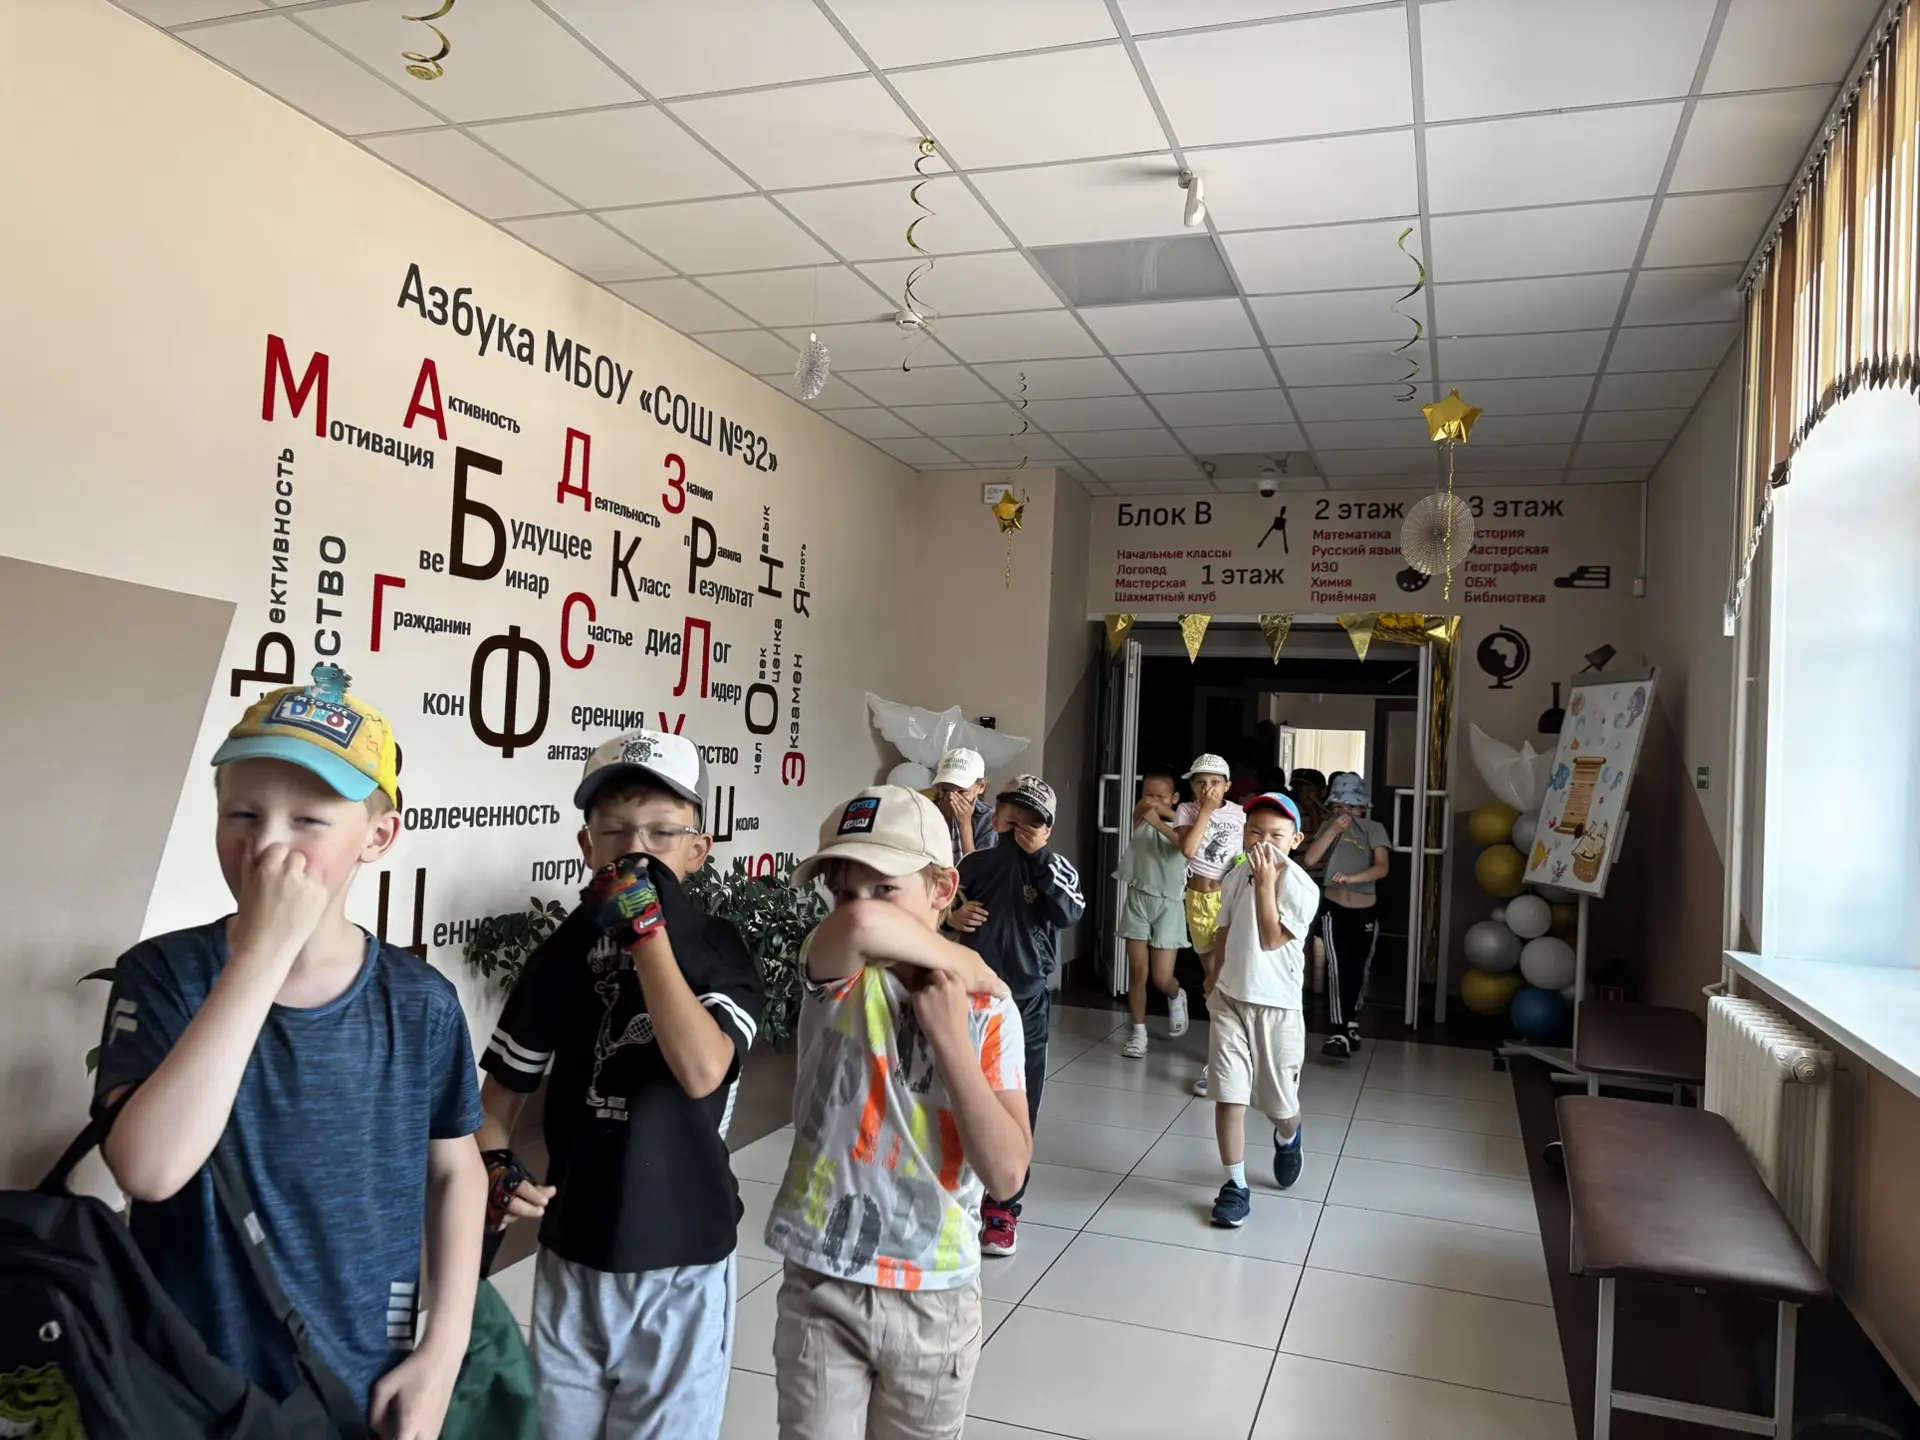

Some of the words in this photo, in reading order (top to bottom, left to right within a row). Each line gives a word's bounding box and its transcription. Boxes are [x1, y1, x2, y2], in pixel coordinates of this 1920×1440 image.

[397, 262, 535, 365] Азбука
[544, 329, 633, 405] МБОУ
[639, 385, 713, 446] «СОШ
[719, 416, 778, 472] №32»
[262, 333, 435, 469] Мотивация
[403, 357, 521, 441] Активность
[557, 427, 661, 528] Деятельность
[662, 453, 713, 514] Знания
[1117, 503, 1186, 527] Блок
[1314, 499, 1330, 520] 2
[1338, 501, 1404, 520] этаж
[1469, 495, 1484, 516] 3
[1492, 498, 1564, 517] этаж
[1312, 529, 1391, 541] Математика
[1472, 528, 1525, 540] стория
[1117, 549, 1184, 560] Начальные
[1186, 548, 1232, 559] классы
[1312, 545, 1366, 557] Русский
[610, 530, 671, 603] Класс
[1116, 564, 1167, 576] Логопед
[1201, 564, 1214, 585] 1
[1221, 566, 1285, 585] этаж
[1311, 561, 1339, 573] ИЗО
[1464, 560, 1537, 573] География
[1115, 578, 1187, 590] Мастерская
[1311, 576, 1352, 588] Химия
[1464, 576, 1497, 588] ОБЖ
[1114, 590, 1185, 602] Шахматный
[1187, 590, 1216, 603] клуб
[1311, 590, 1376, 603] Приёмная
[1464, 591, 1546, 604] Библиотека
[370, 573, 471, 652] Гражданин
[560, 592, 633, 669] Счастье
[289, 701, 345, 728] DINO
[404, 804, 561, 831] овлеченность
[532, 857, 586, 885] погру
